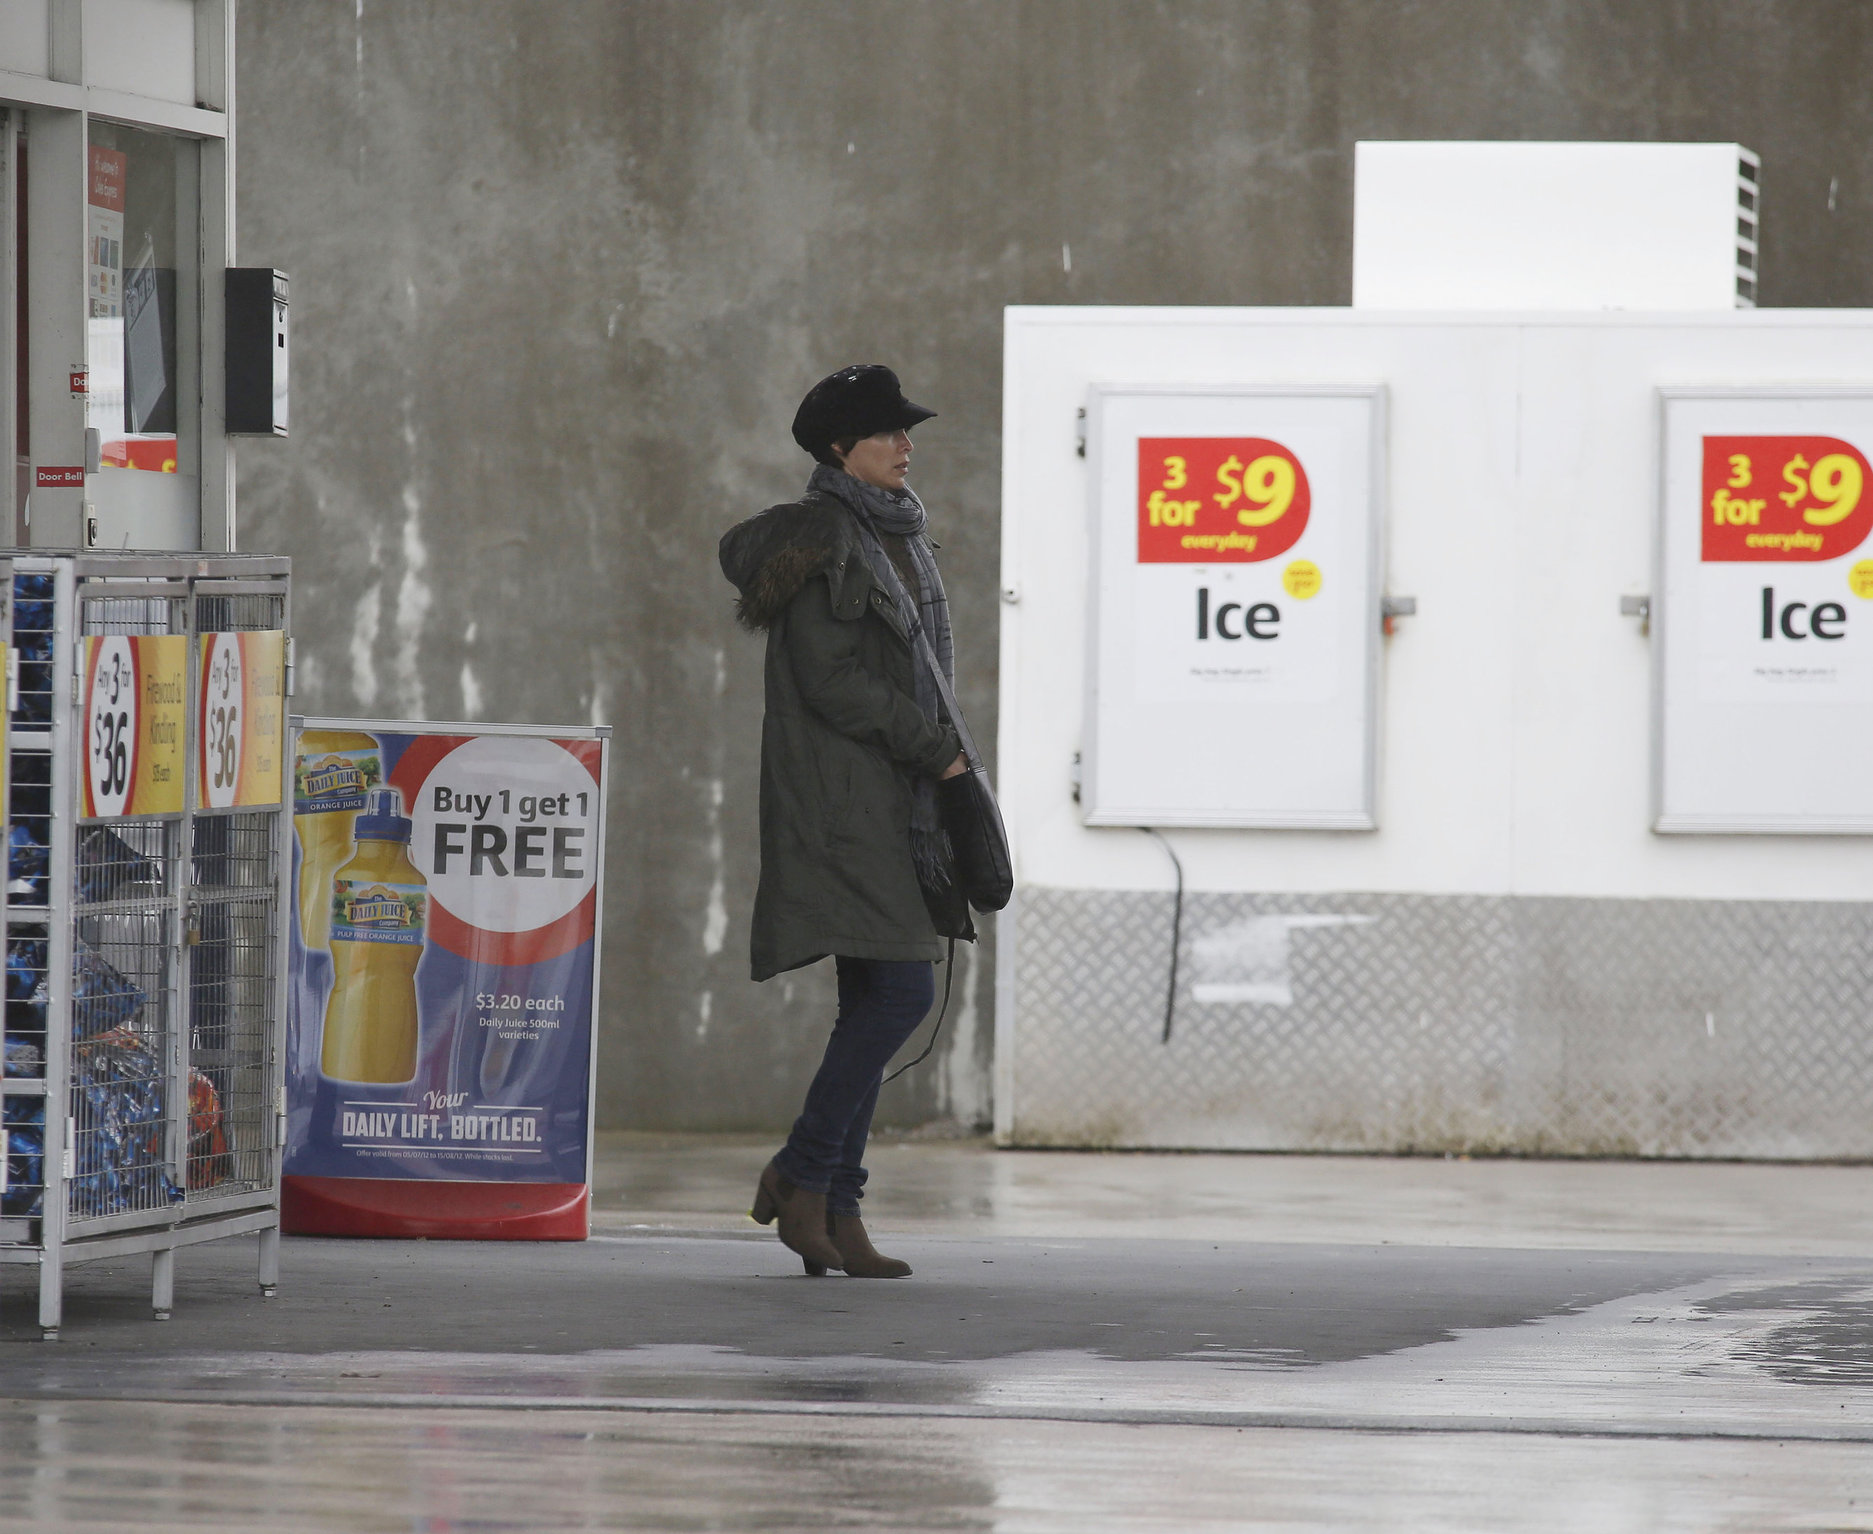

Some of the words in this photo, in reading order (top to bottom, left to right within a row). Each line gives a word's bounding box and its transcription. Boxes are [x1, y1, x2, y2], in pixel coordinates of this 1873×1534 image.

[39, 472, 62, 480] Door
[65, 472, 82, 480] Bell
[1163, 456, 1187, 489] 3
[1727, 454, 1752, 488] 3
[1213, 454, 1295, 527] $9
[1779, 453, 1863, 526] $9
[1147, 490, 1201, 526] for
[1711, 488, 1766, 526] for
[1181, 531, 1257, 553] everyday
[1745, 530, 1824, 552] everyday
[1197, 588, 1280, 640] Ice
[1762, 587, 1847, 640] Ice
[110, 652, 120, 705] 3
[121, 662, 131, 688] for
[222, 648, 230, 700] 3
[231, 658, 239, 682] for
[95, 705, 128, 797] $36
[210, 700, 237, 789] $36
[307, 774, 334, 793] DAILY
[337, 770, 362, 785] JUICE
[310, 802, 340, 811] ORANGE
[343, 800, 362, 809] JUICE
[433, 786, 492, 821] Buy
[499, 789, 510, 814] 1
[519, 793, 570, 822] get
[577, 792, 588, 817] 1
[433, 823, 585, 879] FREE
[351, 905, 378, 920] DAILY
[381, 903, 405, 918] JUICE
[397, 934, 414, 942] JUICE
[476, 992, 521, 1011] $3.20
[525, 994, 565, 1011] each
[479, 1017, 503, 1029] Daily
[504, 1018, 528, 1028] Juice
[529, 1019, 560, 1029] 500ml
[499, 1030, 539, 1040] varieties
[423, 1089, 469, 1110] Your
[342, 1112, 397, 1137] DAILY
[401, 1113, 444, 1141] LIFT,
[451, 1115, 542, 1143] BOTTLED.
[388, 1150, 402, 1158] from
